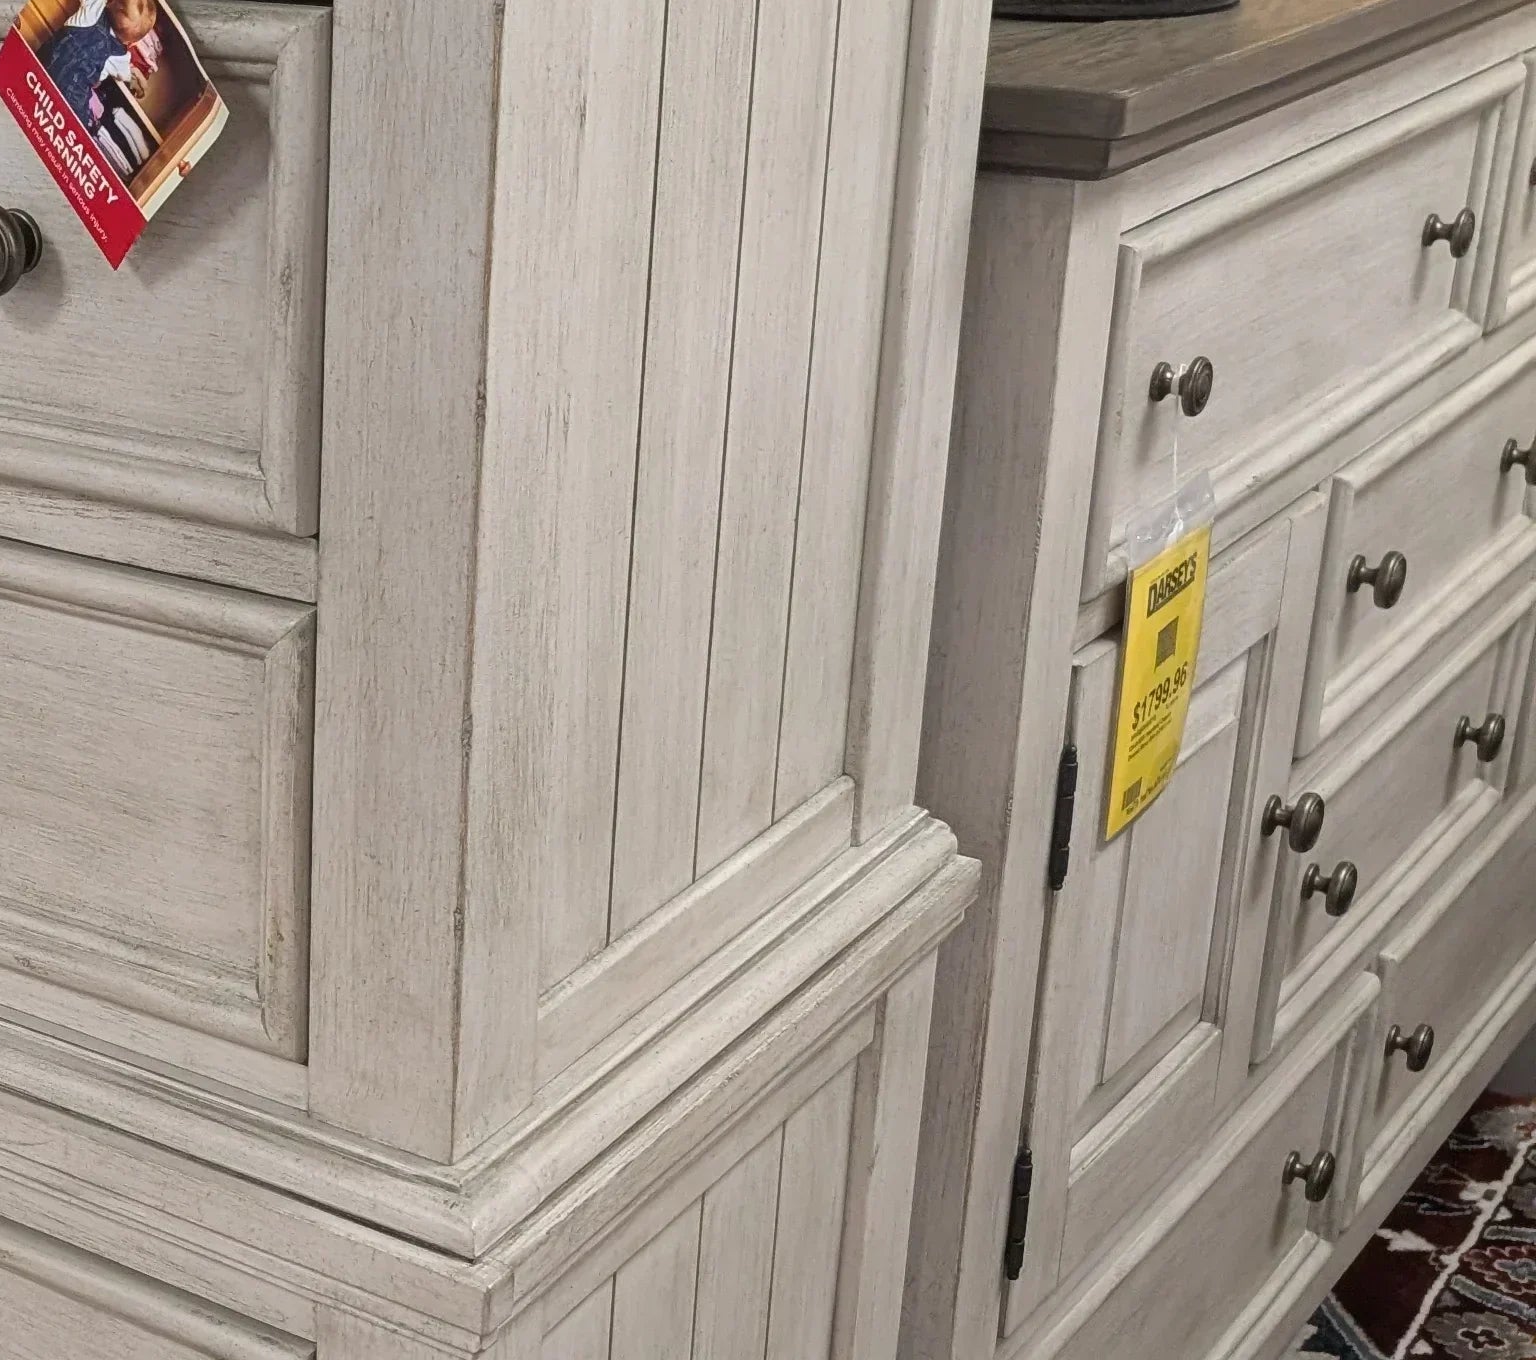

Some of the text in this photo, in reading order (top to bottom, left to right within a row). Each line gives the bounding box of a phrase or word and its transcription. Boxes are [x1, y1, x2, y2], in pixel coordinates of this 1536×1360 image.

[7, 88, 108, 242] Climbing may result in serious injury.
[27, 72, 118, 203] CHILD SAFETY
[34, 102, 95, 199] WARNING
[1147, 552, 1198, 617] DARSEY'S
[1131, 661, 1189, 731] $1799.96
